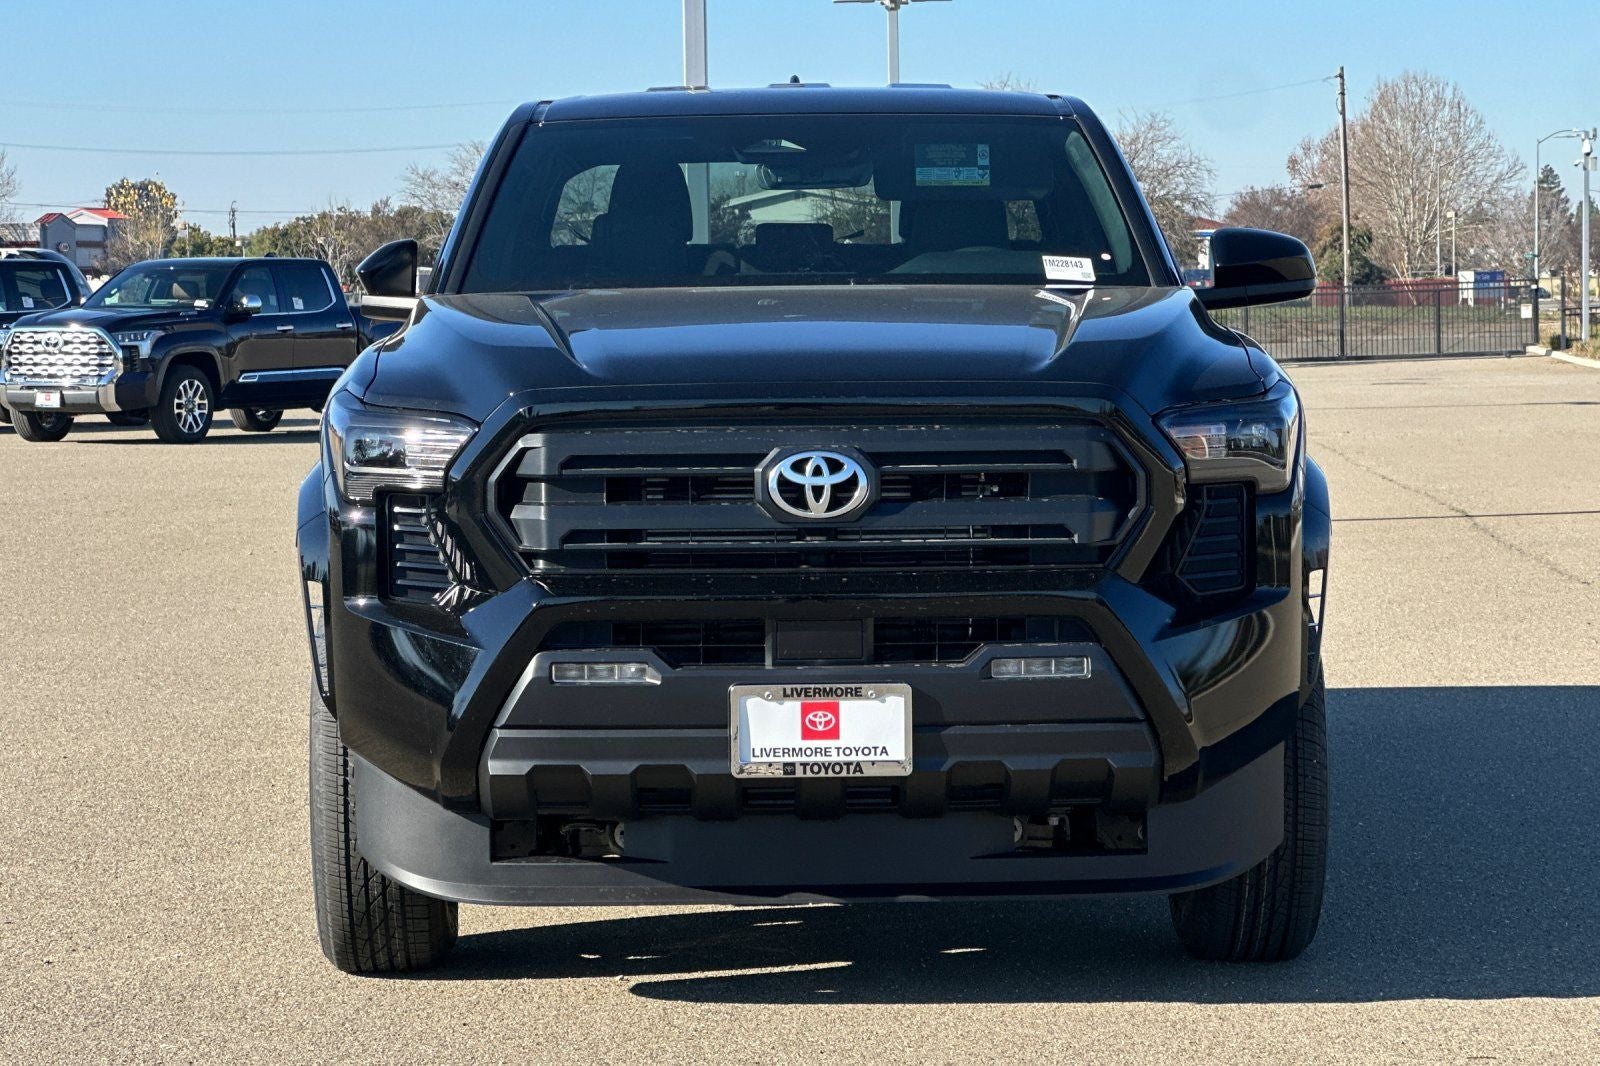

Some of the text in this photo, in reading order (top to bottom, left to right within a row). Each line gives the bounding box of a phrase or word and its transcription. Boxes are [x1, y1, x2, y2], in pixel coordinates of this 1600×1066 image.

[782, 687, 863, 698] LIVERMORE
[752, 746, 889, 758] LIVERMORE TOYOTA
[800, 762, 864, 775] TOYOTA
